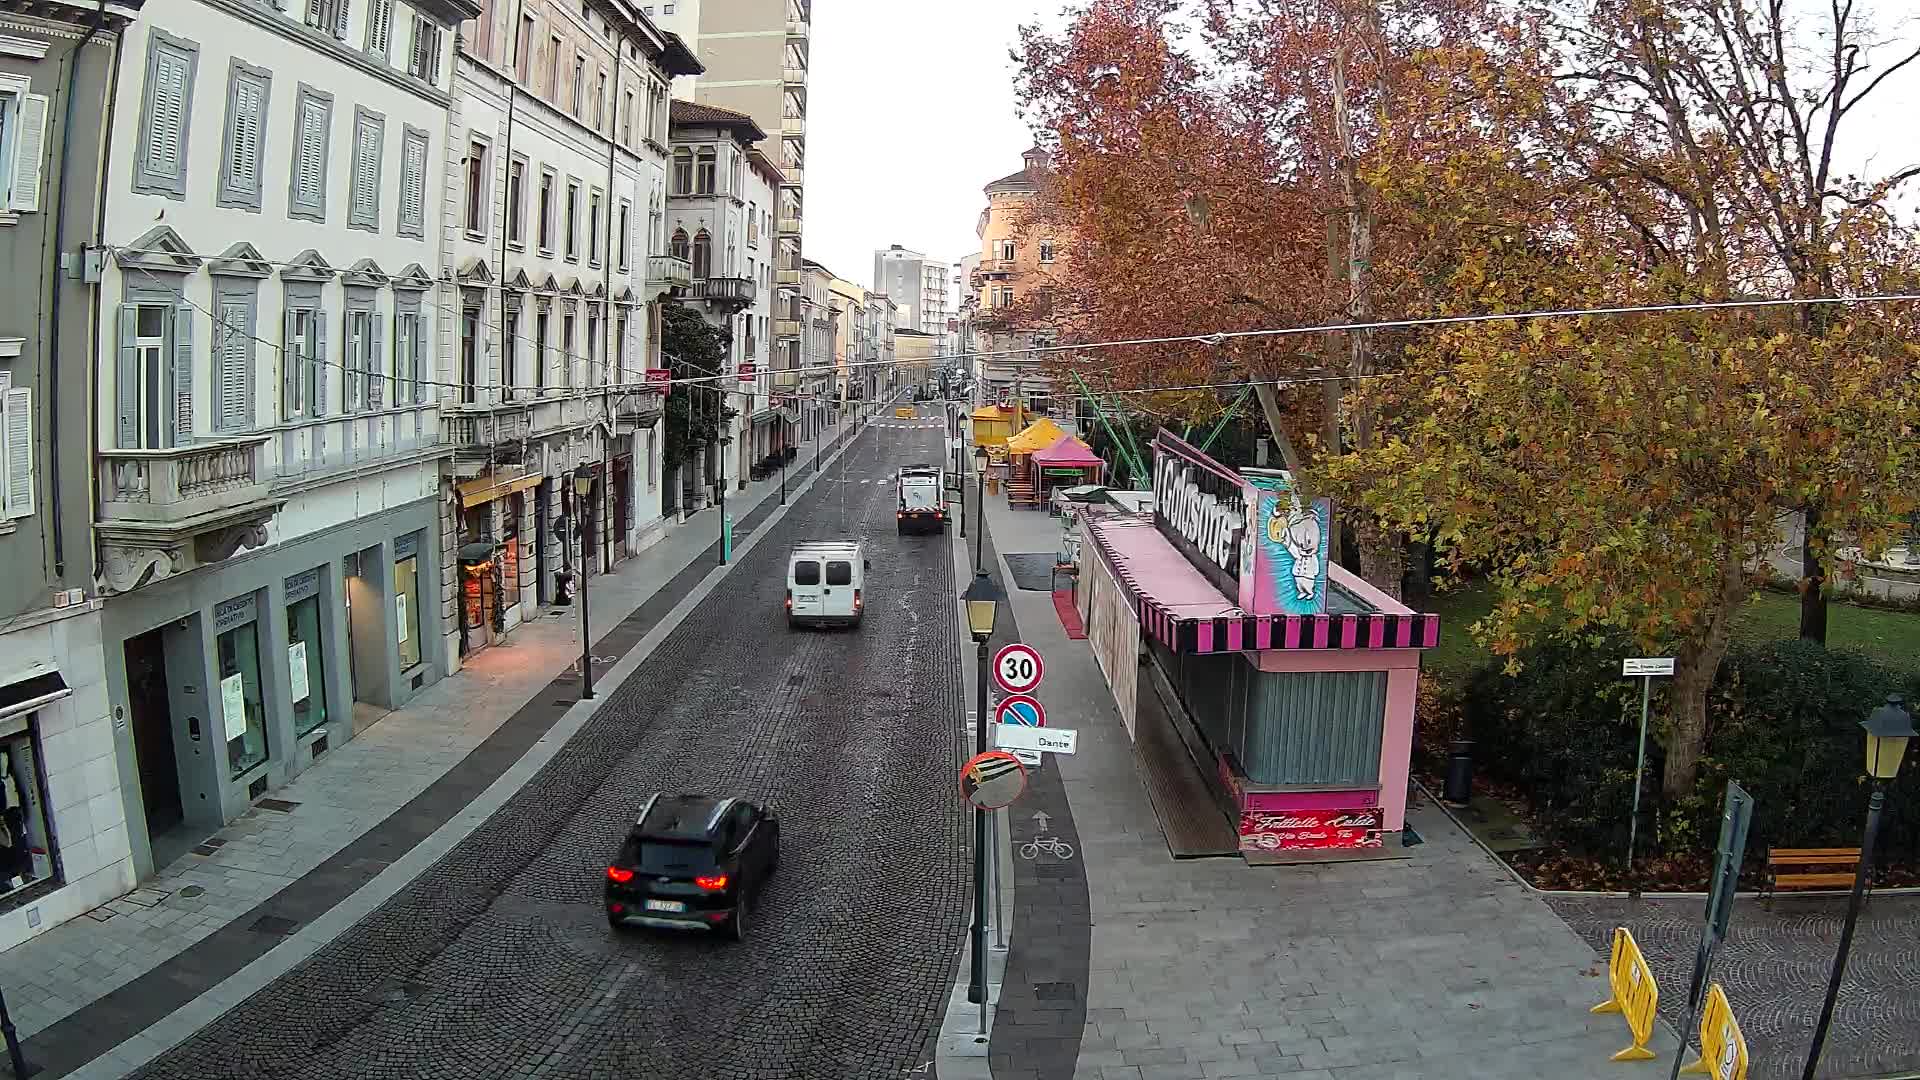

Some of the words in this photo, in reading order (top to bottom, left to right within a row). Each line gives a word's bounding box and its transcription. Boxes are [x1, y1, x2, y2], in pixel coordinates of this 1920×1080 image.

[1163, 459, 1233, 570] Golosone
[1005, 658, 1032, 679] 30
[1038, 738, 1070, 748] Dante
